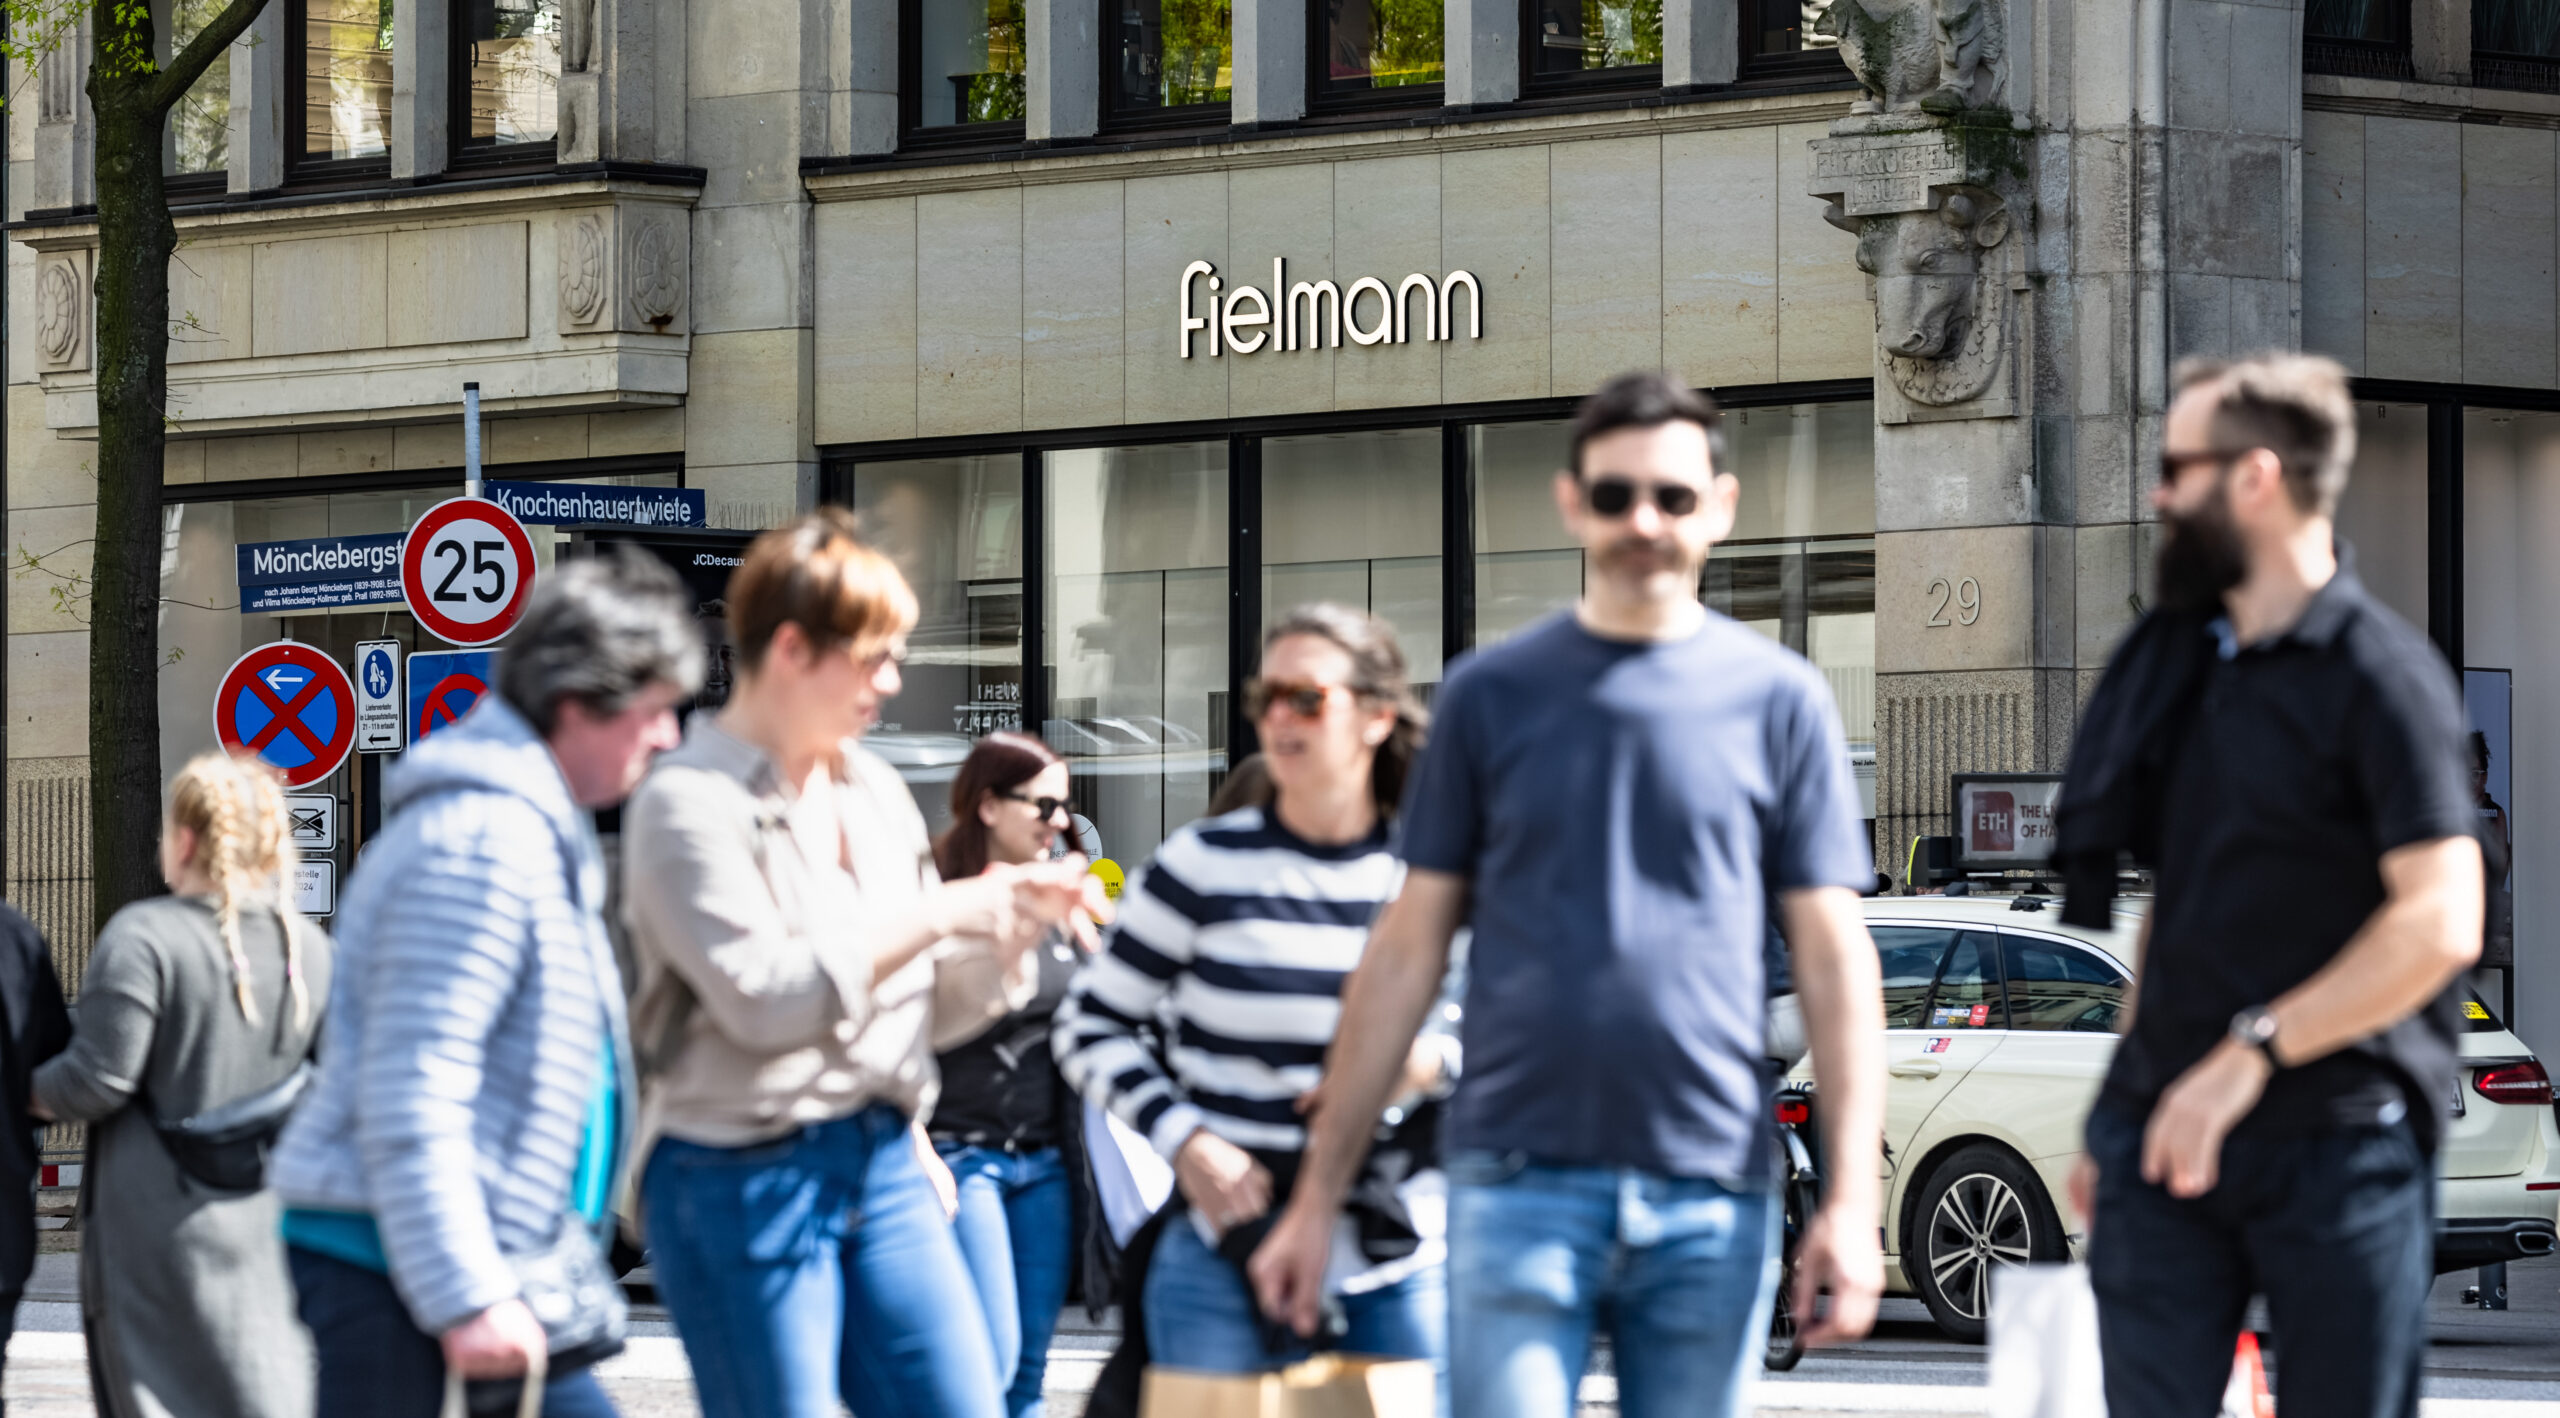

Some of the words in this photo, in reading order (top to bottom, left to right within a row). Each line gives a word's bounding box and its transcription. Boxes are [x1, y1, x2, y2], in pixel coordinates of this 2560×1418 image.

[1181, 257, 1482, 359] fielmann
[497, 488, 692, 522] Knochenhauertwiete
[253, 539, 402, 575] Mönckebergst
[692, 553, 746, 567] JCDecaux
[433, 539, 505, 603] 25
[264, 587, 279, 597] nach
[279, 585, 300, 596] Johann
[300, 585, 318, 596] Georg
[318, 583, 353, 594] Mönckeberg
[386, 579, 402, 588] Erste
[252, 599, 264, 608] und
[264, 597, 281, 608] Vilma
[1926, 576, 1981, 628] 29
[2020, 804, 2041, 819] THE
[1978, 812, 2009, 831] ETH
[2020, 824, 2037, 839] OF
[2039, 824, 2058, 839] HA
